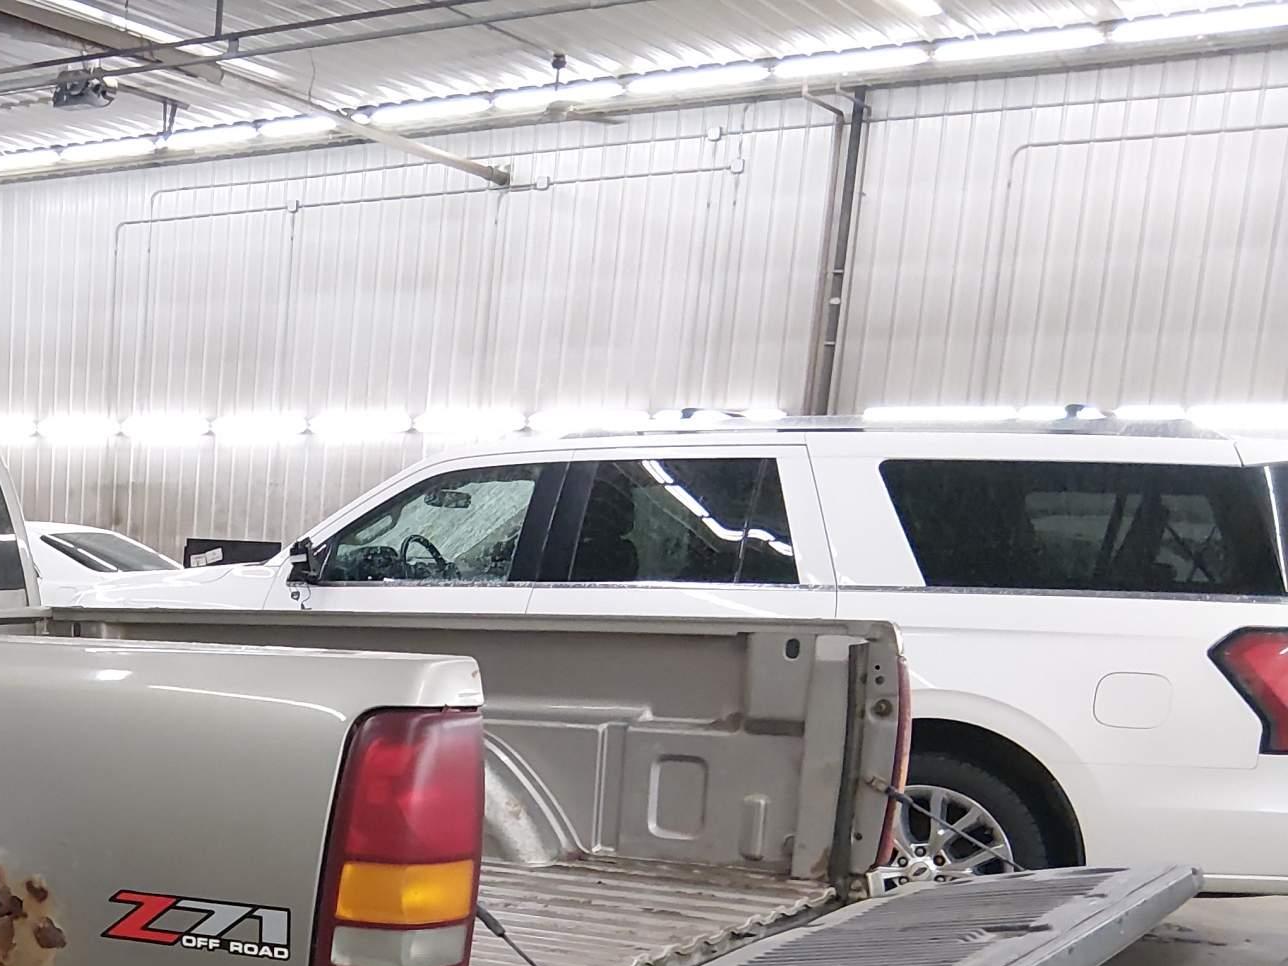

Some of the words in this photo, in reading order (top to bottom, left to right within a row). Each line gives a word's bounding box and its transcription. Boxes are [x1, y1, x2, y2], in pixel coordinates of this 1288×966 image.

[101, 890, 291, 946] Z71
[180, 934, 221, 950] OFF
[228, 940, 290, 960] ROAD
